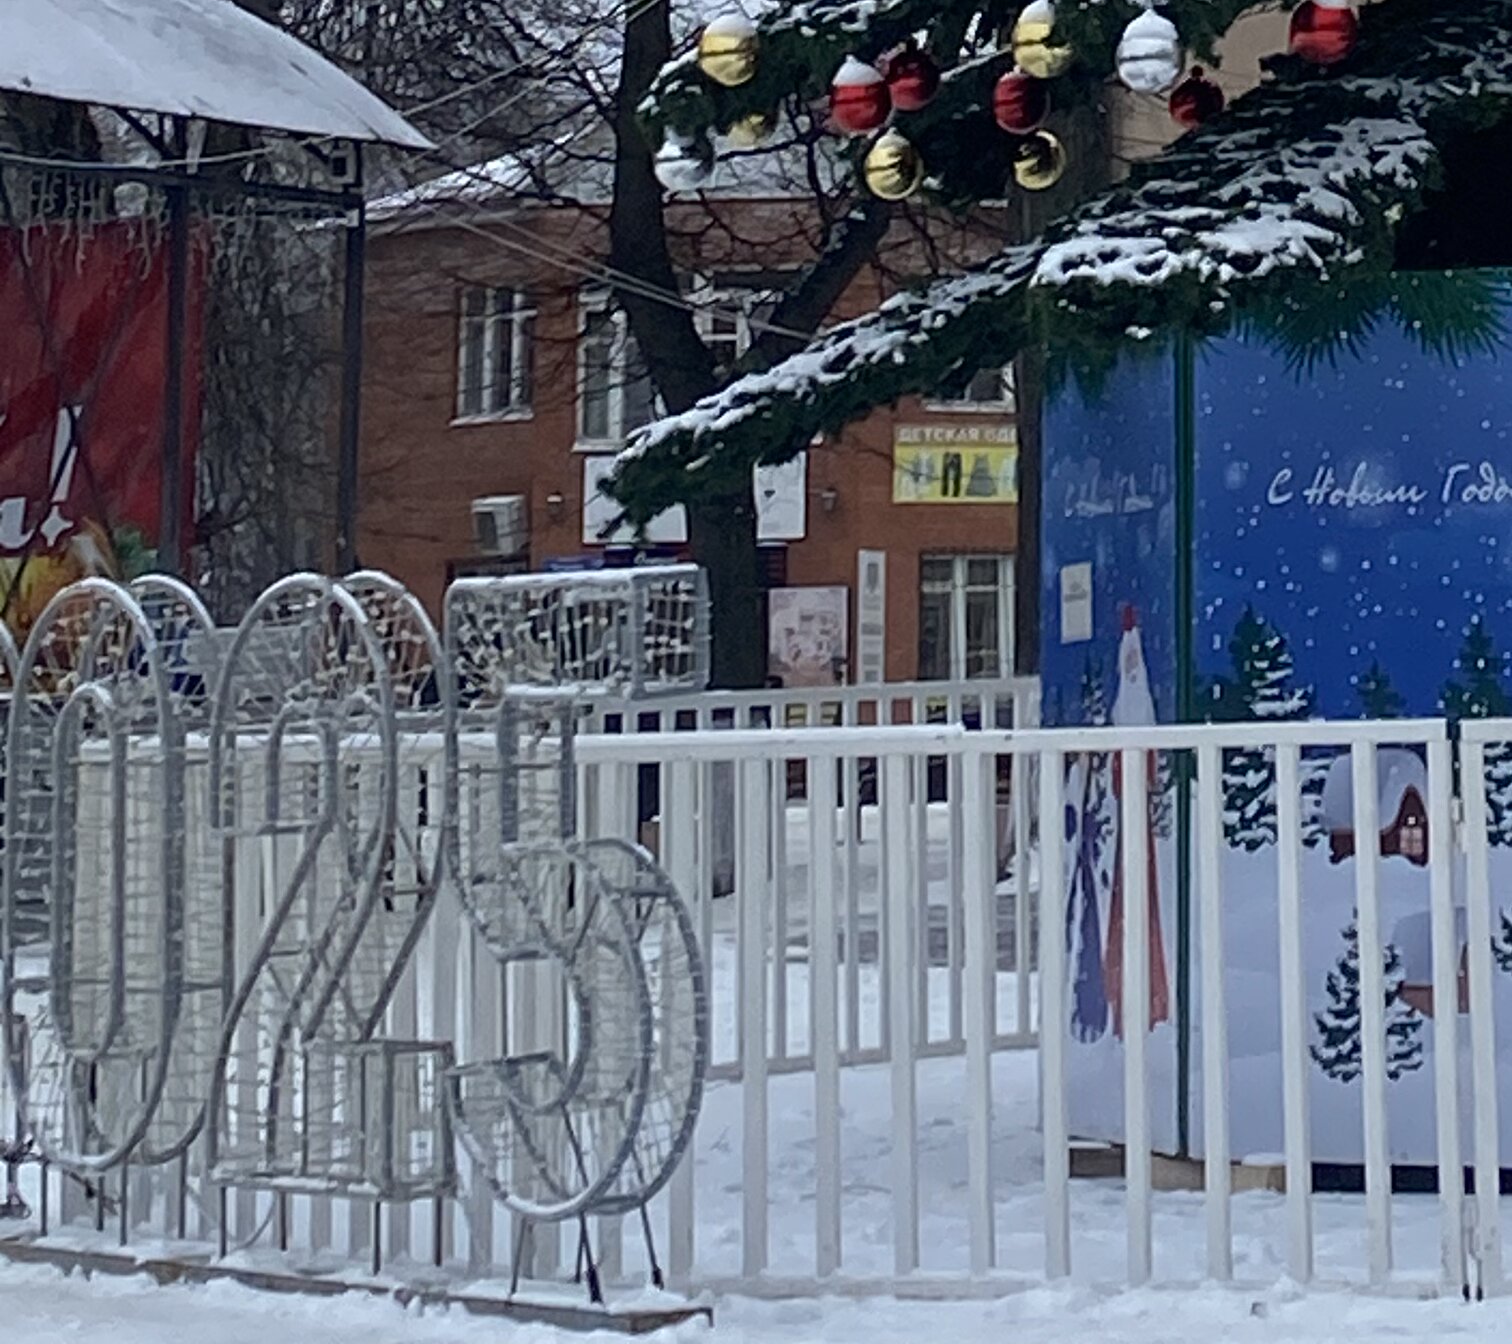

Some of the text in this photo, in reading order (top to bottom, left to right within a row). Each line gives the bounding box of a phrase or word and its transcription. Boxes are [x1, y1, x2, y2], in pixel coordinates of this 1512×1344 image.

[898, 426, 978, 443] ДЕТСКАЯ
[1267, 468, 1293, 504] С
[1303, 461, 1428, 508] Новым
